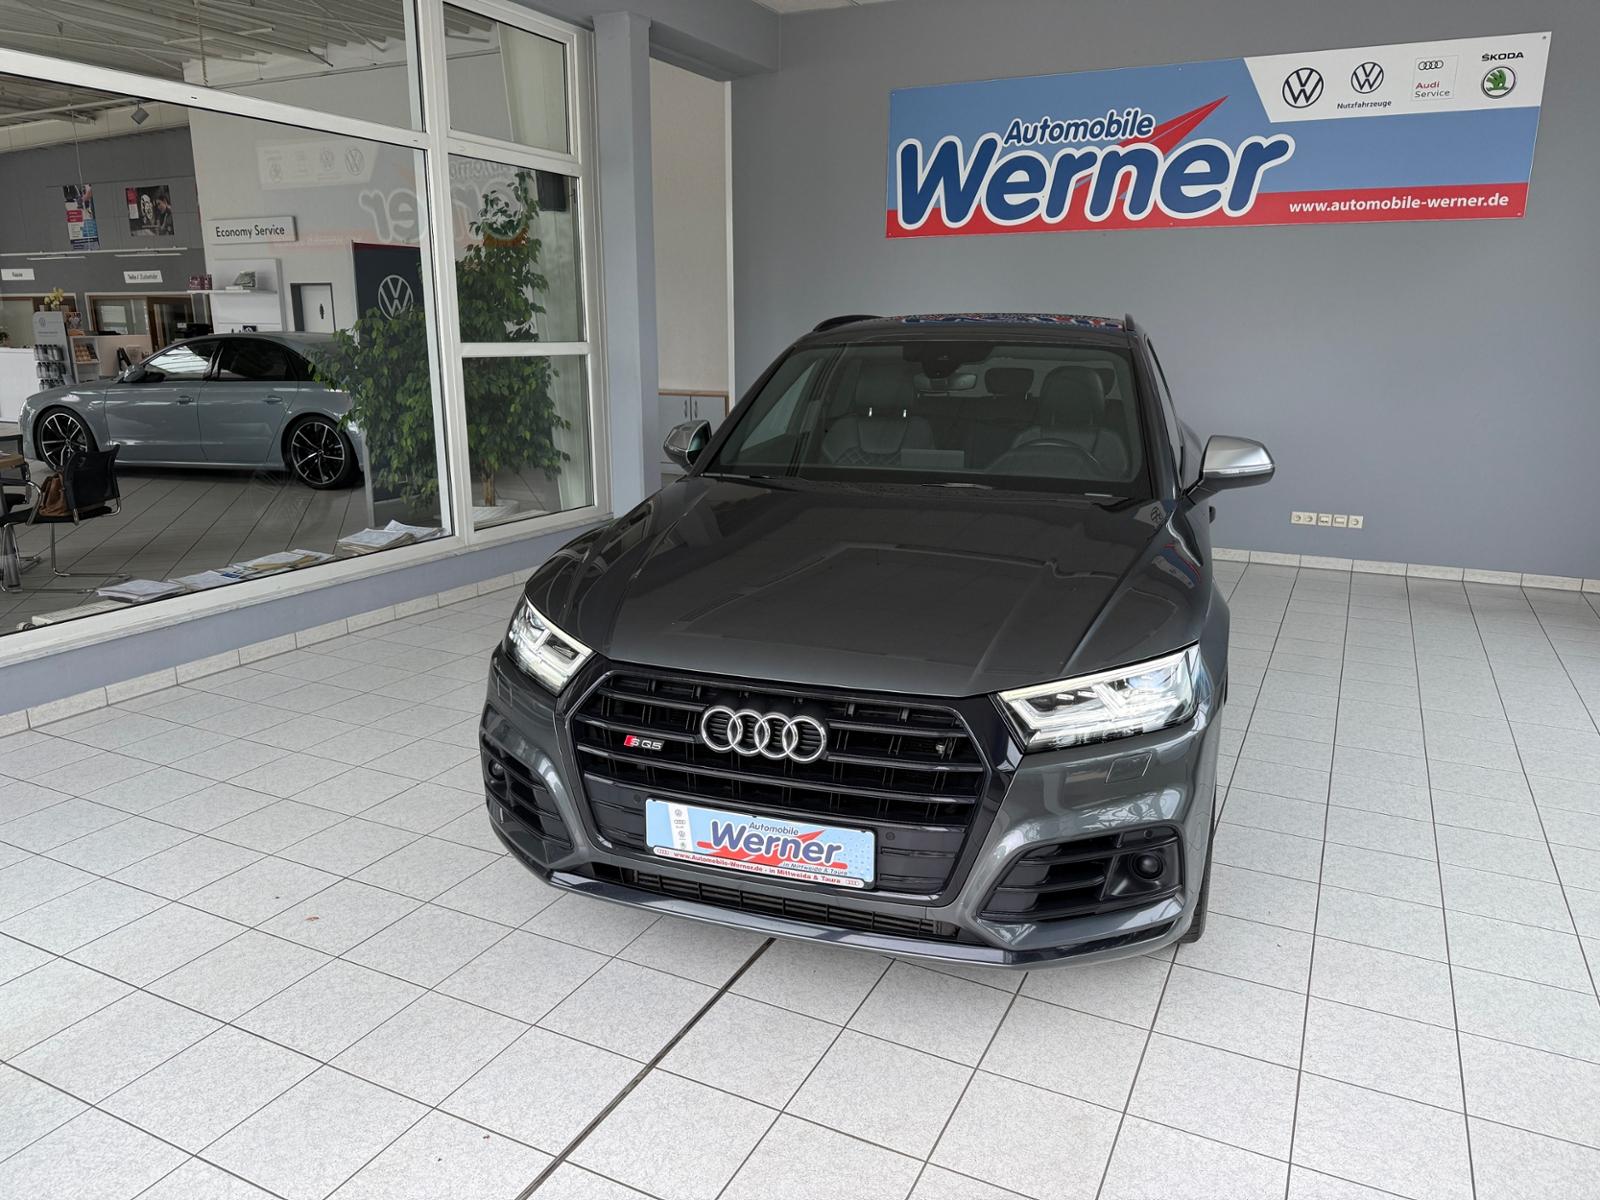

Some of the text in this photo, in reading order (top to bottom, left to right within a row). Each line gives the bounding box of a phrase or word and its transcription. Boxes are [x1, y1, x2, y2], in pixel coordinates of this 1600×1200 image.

[1482, 52, 1524, 62] ŠKODA
[1415, 81, 1441, 90] Audi
[1415, 89, 1451, 98] Service
[1337, 100, 1392, 110] Nutzfahrzeuge
[1003, 108, 1156, 146] Automobile
[898, 133, 1295, 229] Werner
[1289, 193, 1509, 212] www.automobile-werner.de
[215, 224, 285, 239] Economy Service
[749, 822, 799, 836] Automobile
[711, 820, 843, 865] Werner
